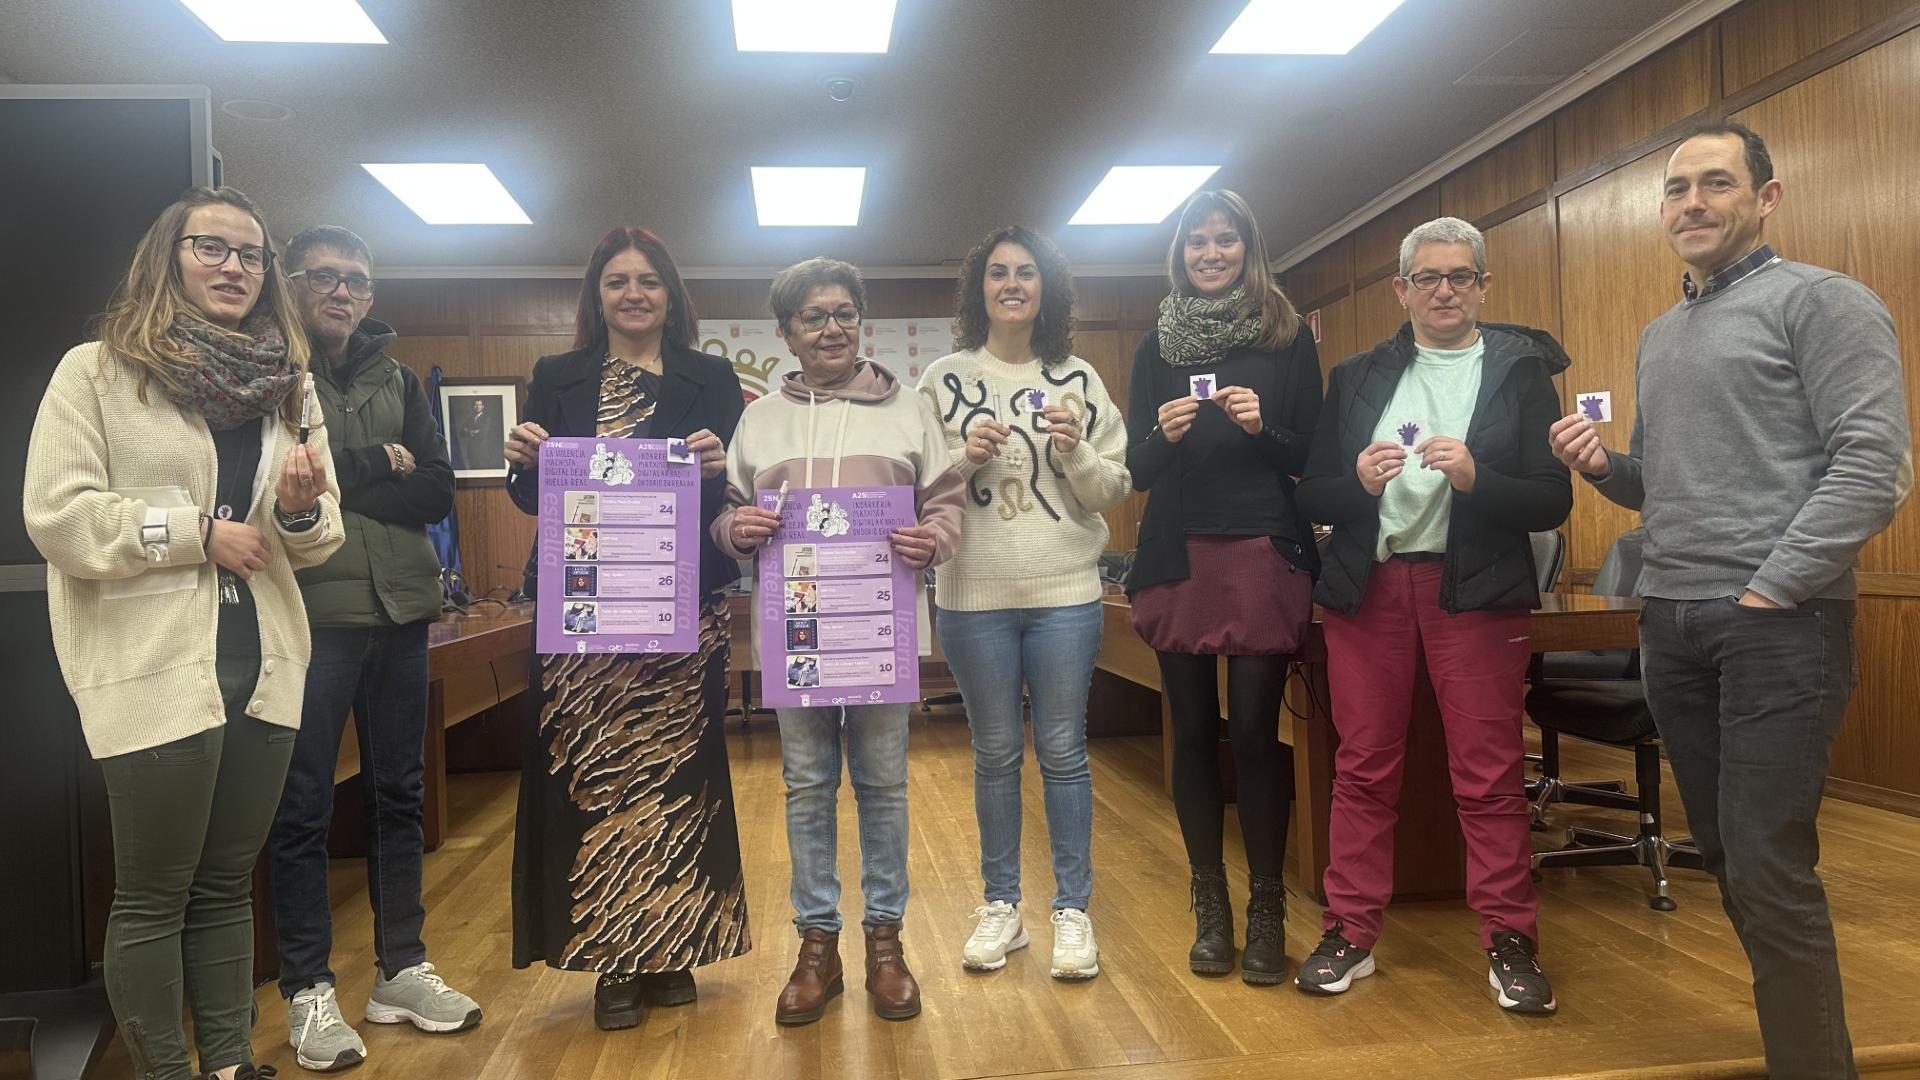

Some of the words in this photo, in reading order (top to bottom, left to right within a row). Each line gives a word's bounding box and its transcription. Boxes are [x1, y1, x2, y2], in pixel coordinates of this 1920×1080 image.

[545, 450, 554, 458] LA
[556, 450, 586, 458] VIOLENCIA
[638, 452, 667, 460] INDARKE
[638, 461, 669, 469] MATXIST
[544, 468, 569, 476] DIGITAL
[570, 468, 588, 477] DEJA
[544, 478, 569, 487] HUELLA
[570, 478, 588, 487] REAL
[659, 504, 674, 515] 24
[852, 500, 892, 509] INDARKERIA
[543, 492, 562, 567] estella
[789, 530, 807, 540] REAL
[659, 541, 674, 552] 25
[875, 553, 889, 564] 24
[658, 575, 673, 586] 26
[765, 546, 783, 621] estella
[678, 561, 697, 629] lizarra
[877, 590, 891, 602] 25
[658, 612, 672, 622] 10
[877, 625, 892, 636] 26
[895, 609, 914, 680] lizarra
[879, 663, 893, 672] 10
